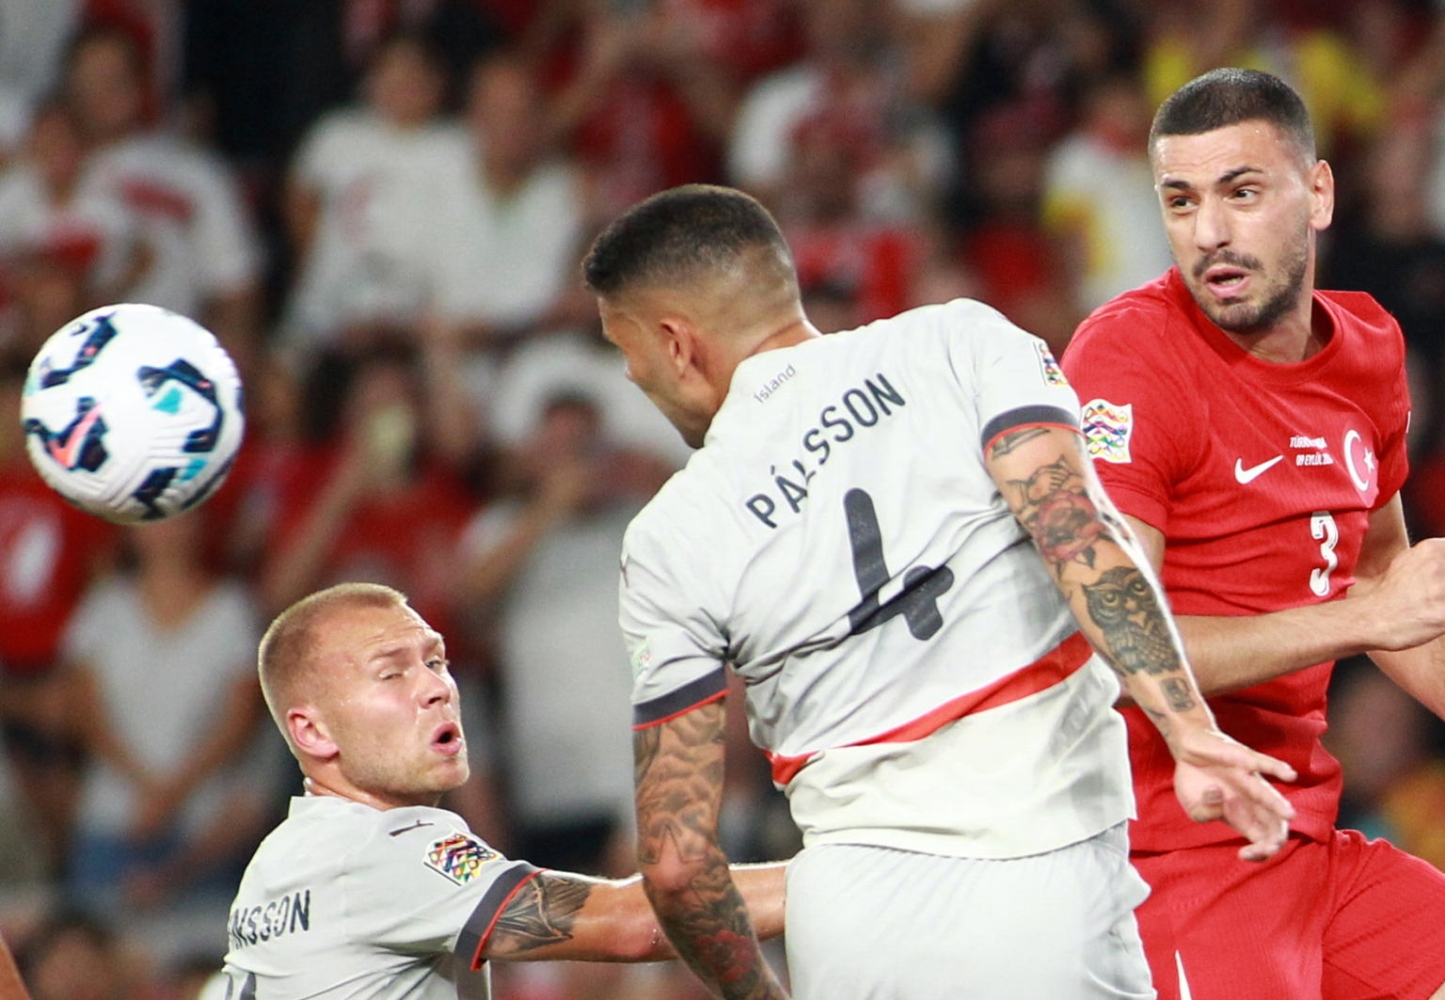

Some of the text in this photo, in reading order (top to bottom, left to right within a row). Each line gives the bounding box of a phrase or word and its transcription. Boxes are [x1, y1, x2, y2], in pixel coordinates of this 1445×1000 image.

[745, 372, 906, 529] PÁLSSON
[843, 488, 954, 641] 4
[1309, 511, 1339, 597] 3
